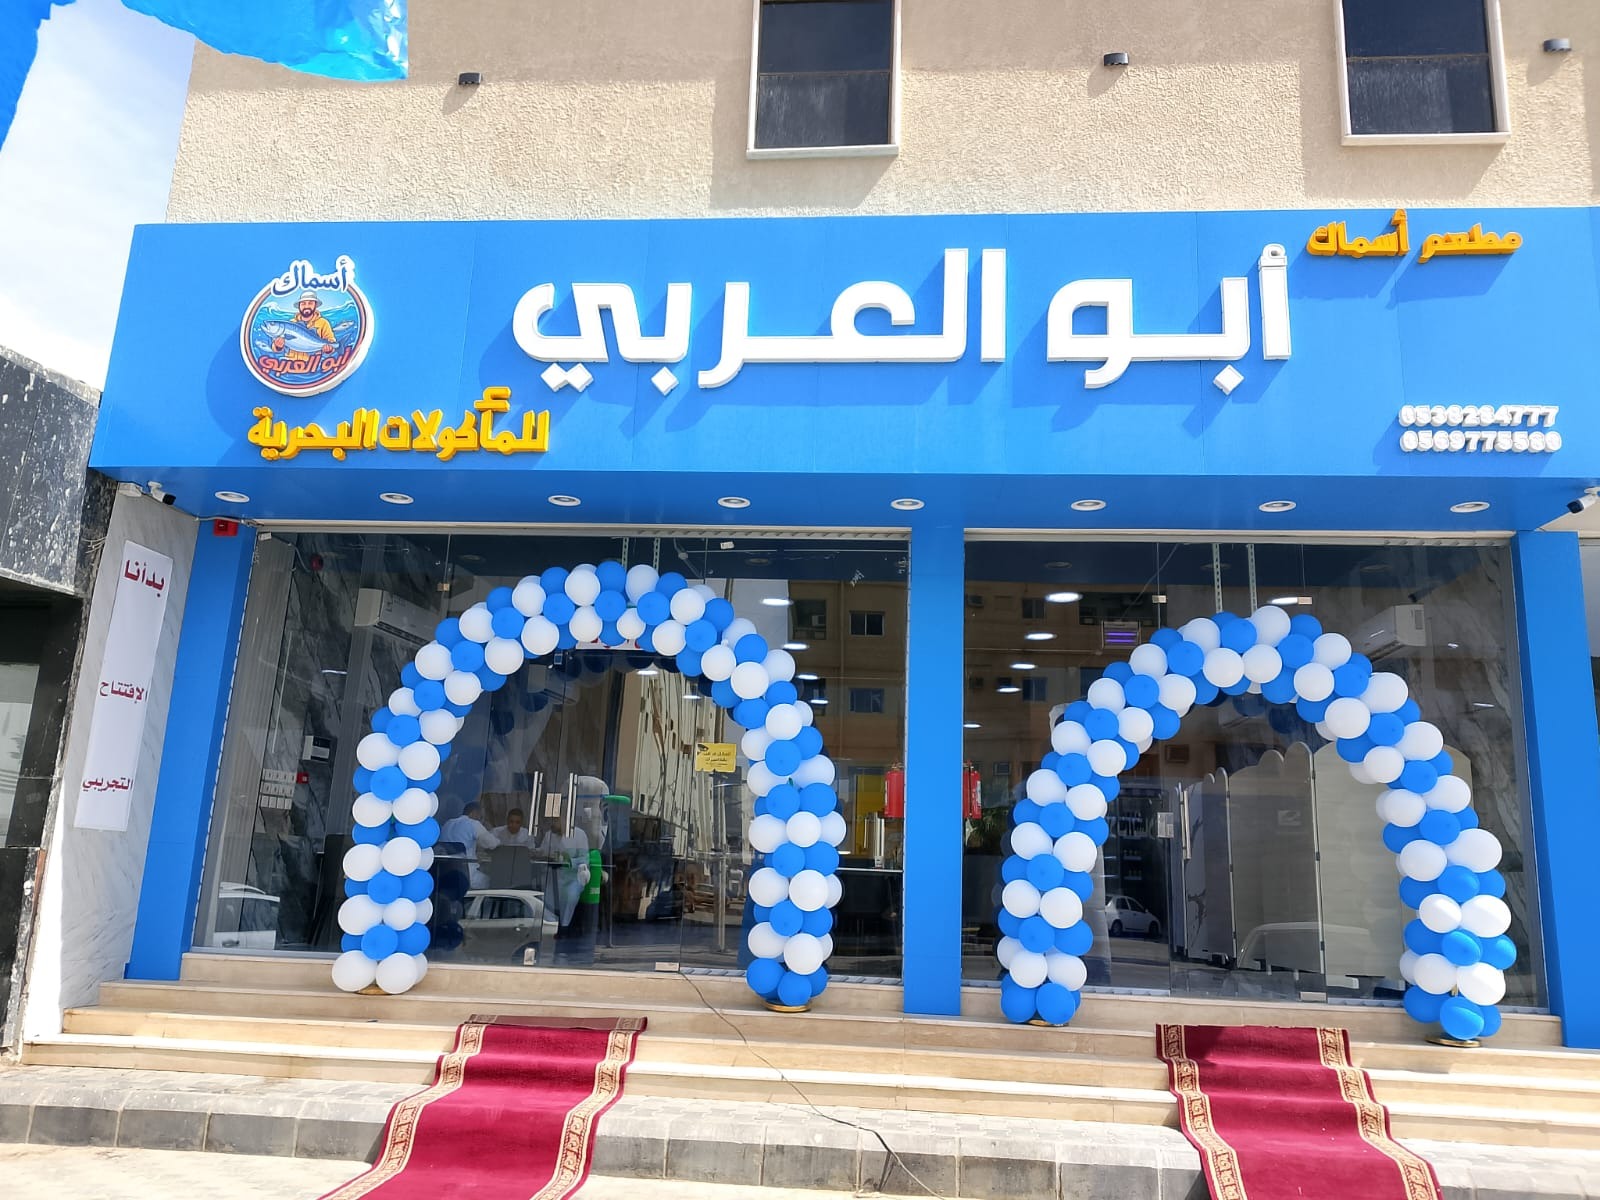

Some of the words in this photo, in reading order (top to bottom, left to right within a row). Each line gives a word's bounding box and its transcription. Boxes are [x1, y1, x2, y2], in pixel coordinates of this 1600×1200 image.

[1307, 208, 1410, 259] أسماك
[1418, 223, 1523, 264] مطعم
[272, 258, 348, 295] أسماك
[512, 248, 1006, 396] العربي
[1047, 244, 1292, 395] أبو
[259, 352, 321, 377] العربي
[248, 406, 379, 460] البحرية
[379, 386, 550, 461] للمأكولات
[124, 559, 165, 598] بدأنا
[82, 776, 134, 793] التجريبي
